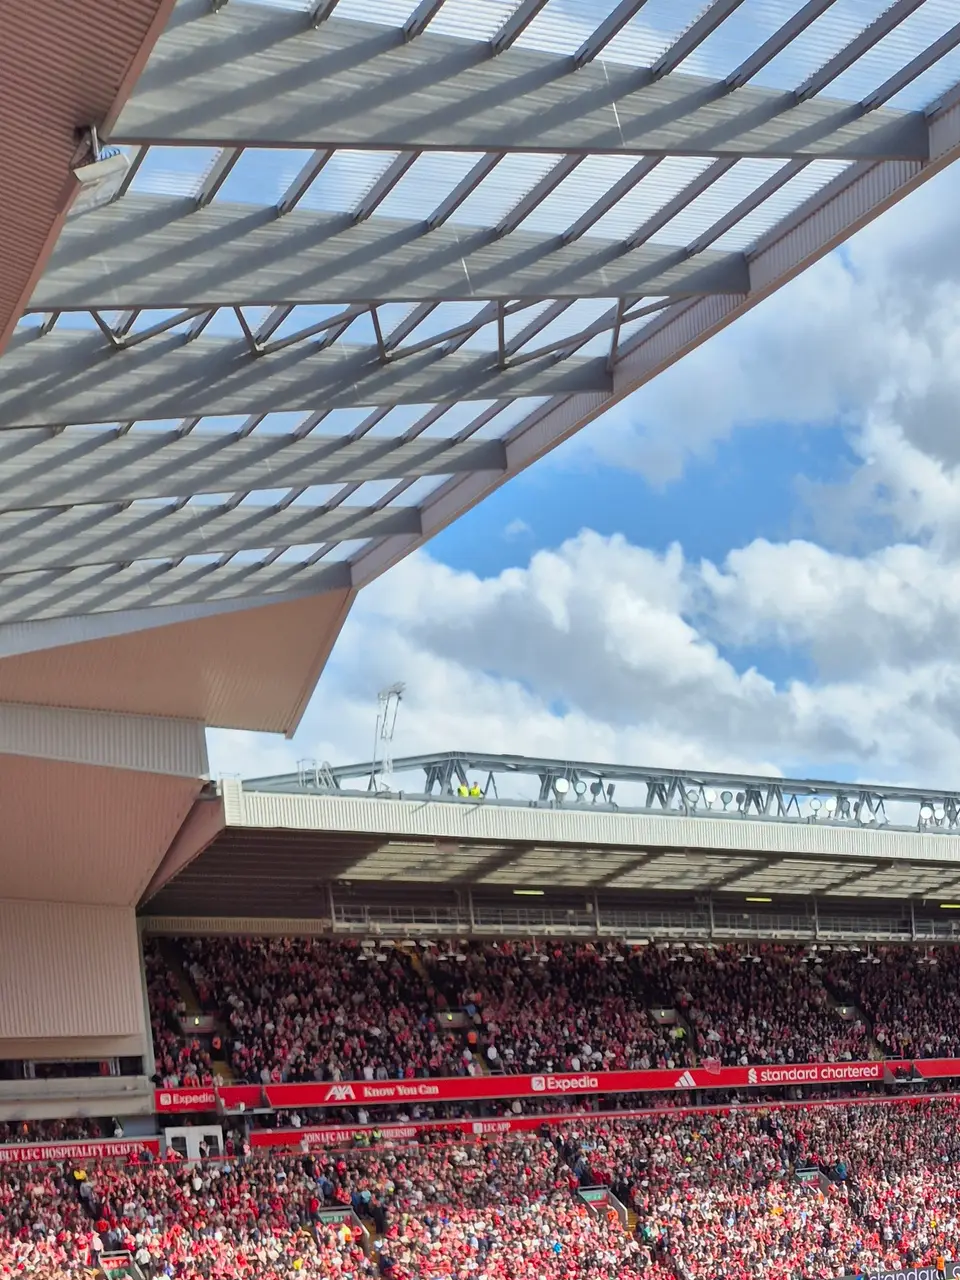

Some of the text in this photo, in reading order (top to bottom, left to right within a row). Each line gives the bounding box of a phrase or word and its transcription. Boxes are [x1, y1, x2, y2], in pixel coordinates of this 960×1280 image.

[761, 1064, 878, 1082] standard chartered
[547, 1076, 598, 1090] Expedia
[172, 1092, 215, 1106] Expedia
[324, 1084, 439, 1100] AXA Know You Can
[496, 1122, 510, 1131] APP
[304, 1132, 321, 1143] JOIN
[321, 1131, 335, 1143] LFC
[336, 1130, 351, 1142] ALL
[0, 1143, 145, 1161] BUY LFC HOSPITALITY TICKETS
